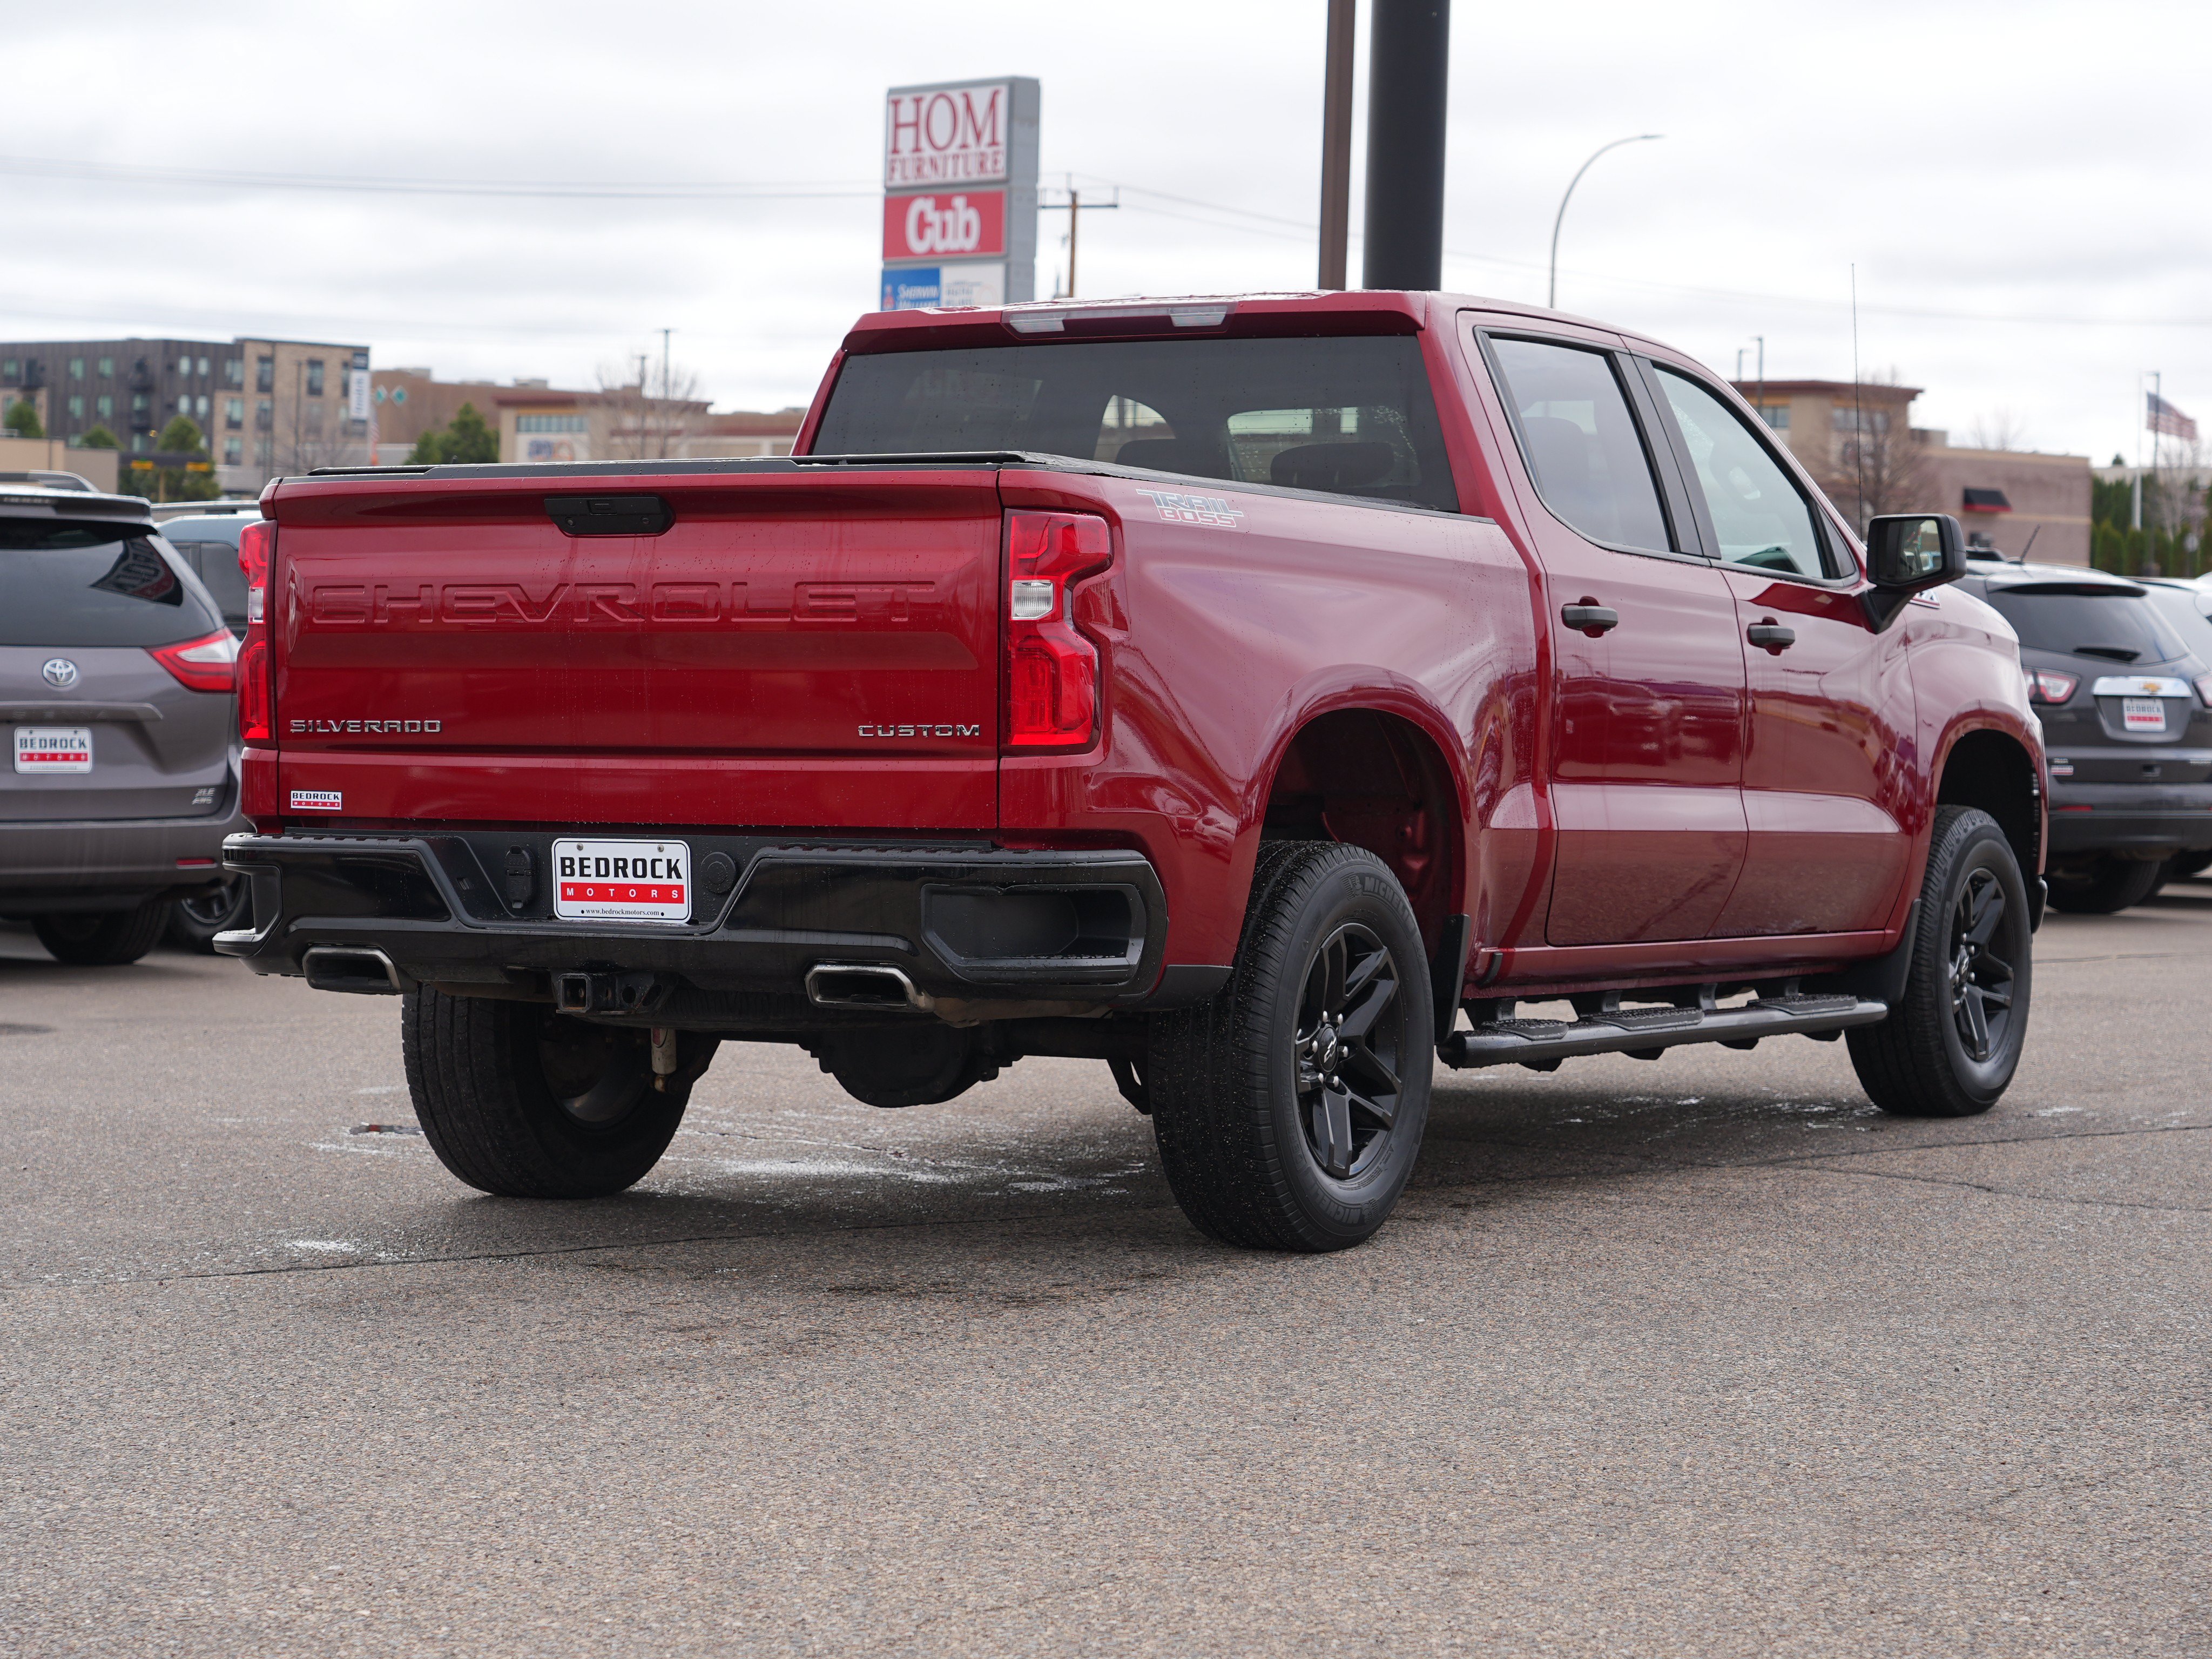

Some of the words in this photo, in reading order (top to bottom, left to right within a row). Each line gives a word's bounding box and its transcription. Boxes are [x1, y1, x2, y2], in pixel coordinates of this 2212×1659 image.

[889, 90, 1001, 154] HOM
[888, 151, 1004, 181] FURNITURE
[905, 195, 981, 254] Cub
[1135, 489, 1244, 517] TRAIL
[1157, 506, 1237, 528] BOSS
[313, 581, 935, 623] CHEVROLET
[290, 720, 442, 733] SILVERADO
[858, 724, 980, 737] CUSTOM
[19, 737, 87, 750] BEDROCK
[292, 792, 340, 800] BEDROCK
[560, 857, 683, 879] BEDROCK
[567, 887, 678, 899] MOTORS
[585, 908, 659, 916] www.bedrockmotors.com
[1364, 876, 1415, 933] MICHELIN
[1302, 1173, 1361, 1224] MICHELIN
